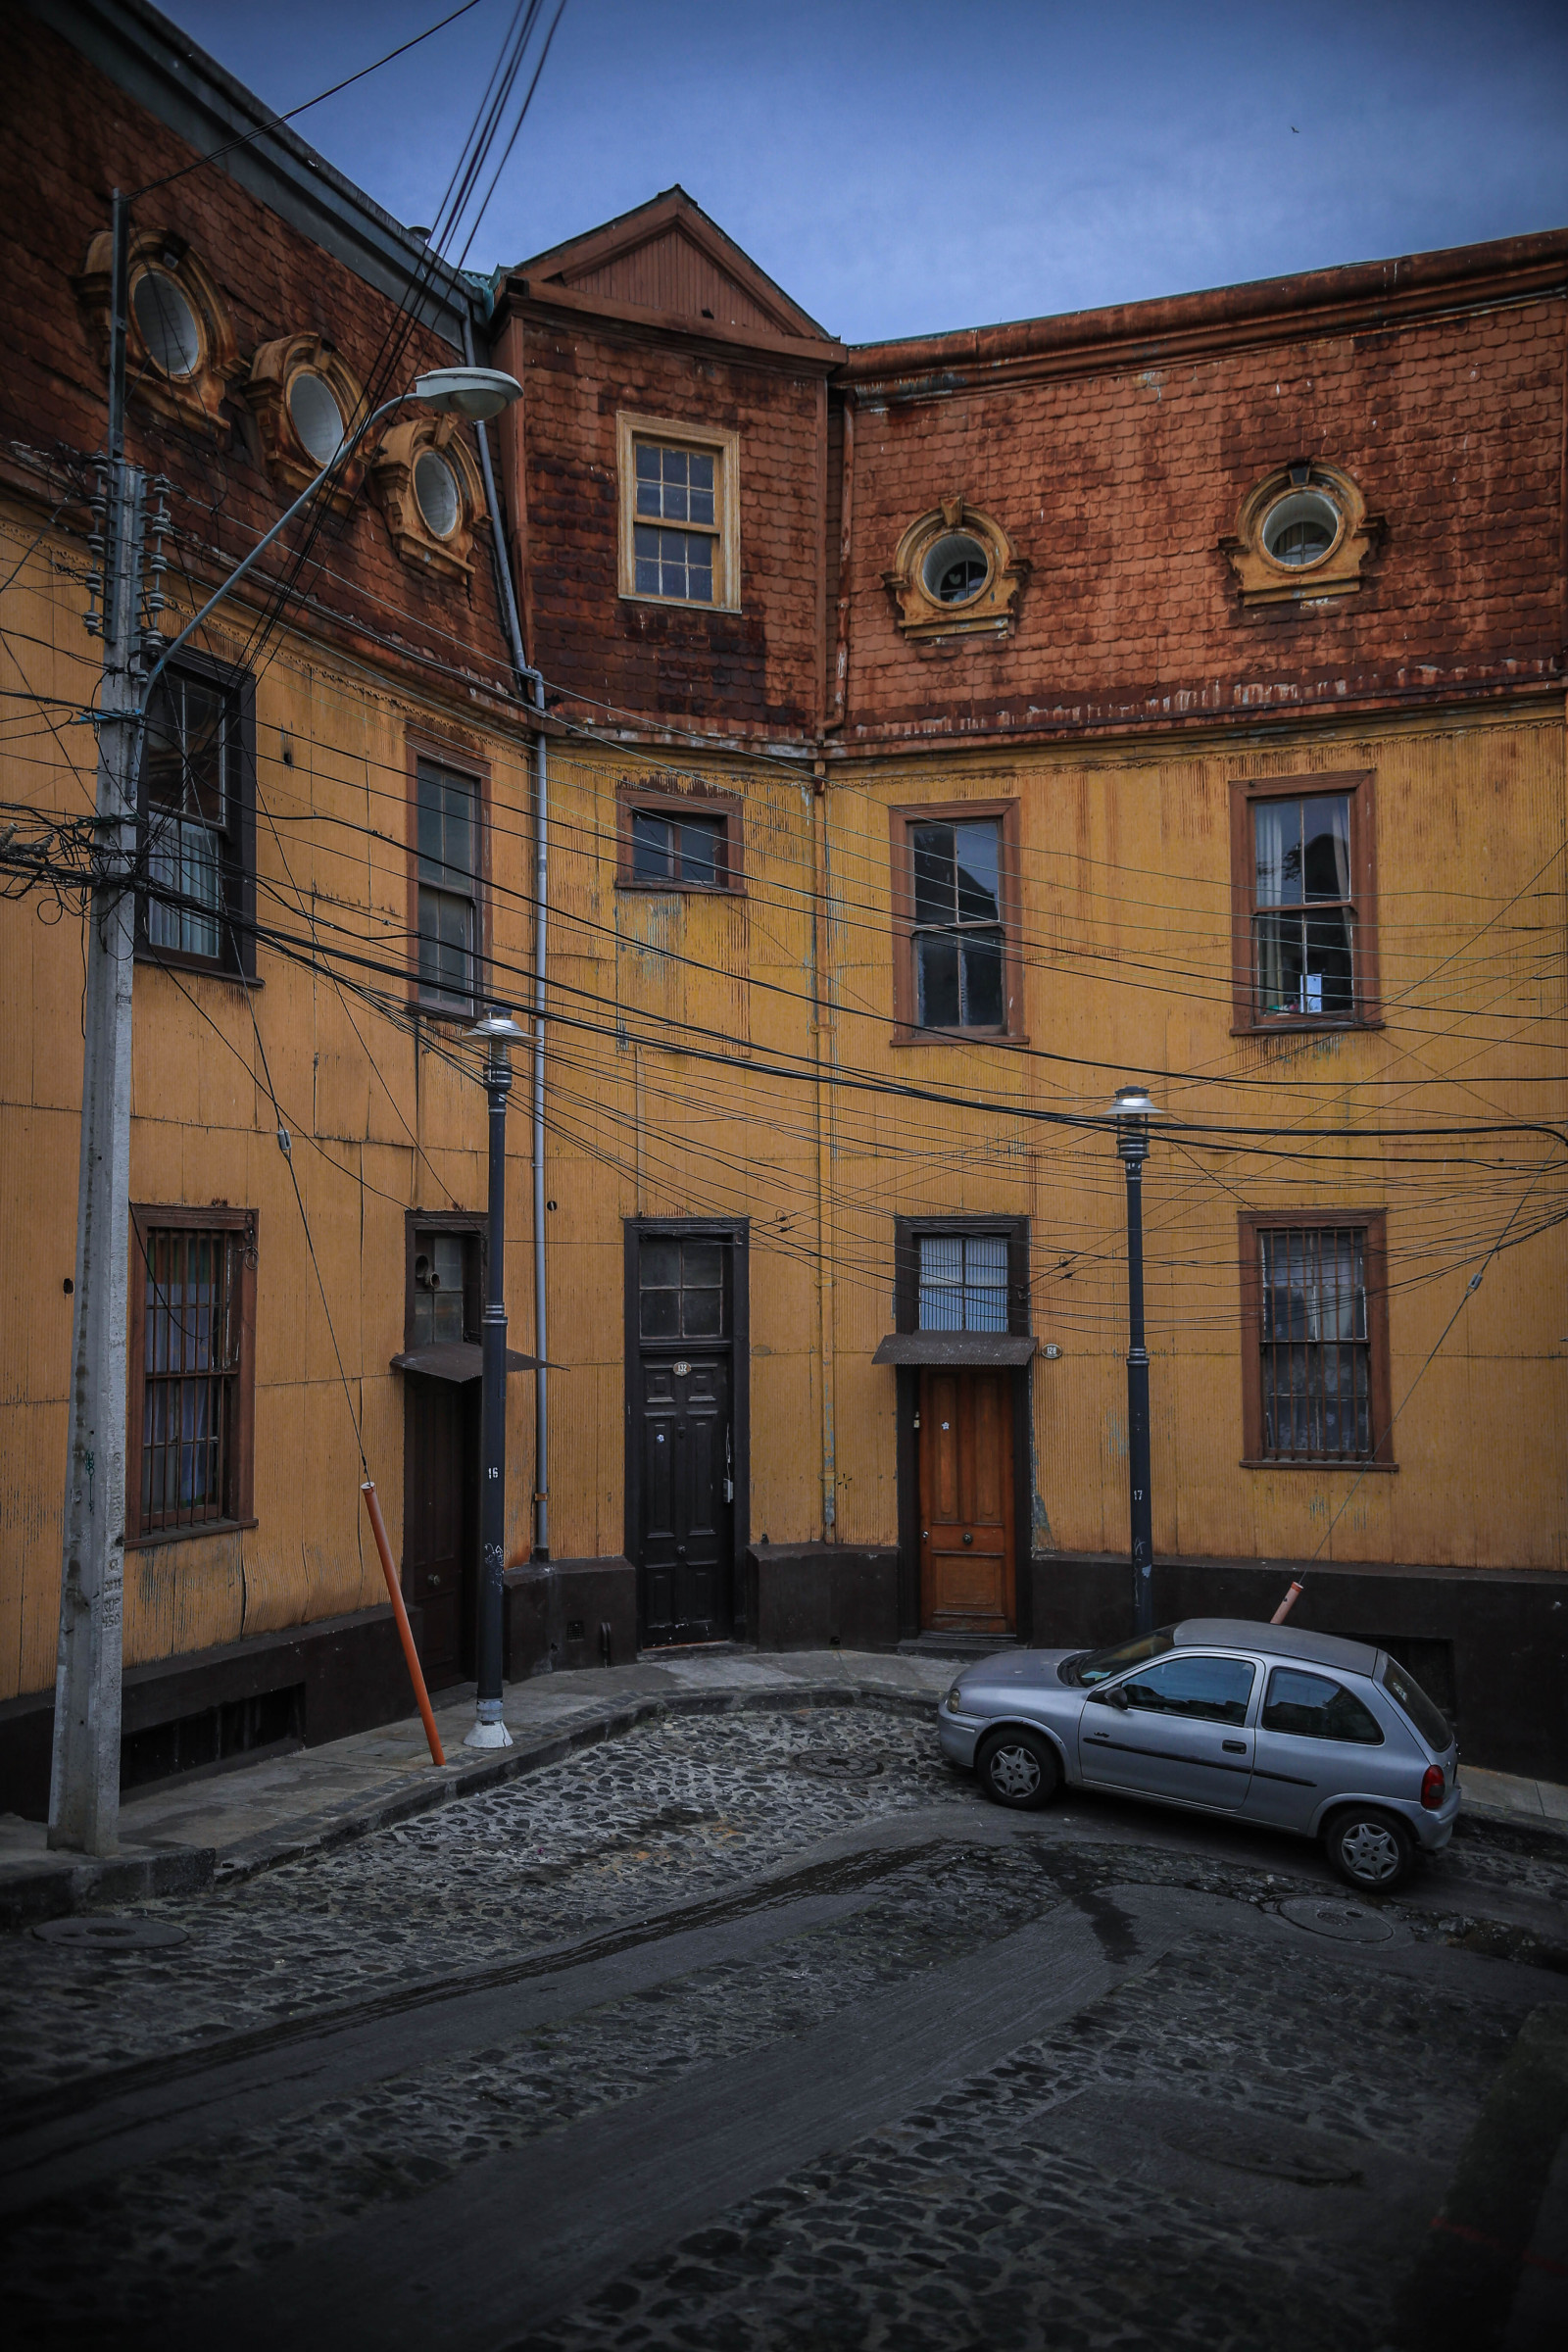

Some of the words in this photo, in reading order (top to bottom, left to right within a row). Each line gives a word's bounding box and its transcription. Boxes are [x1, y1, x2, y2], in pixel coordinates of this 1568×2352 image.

[677, 1363, 688, 1372] 132
[488, 1466, 499, 1480] 16
[1133, 1490, 1143, 1501] 17
